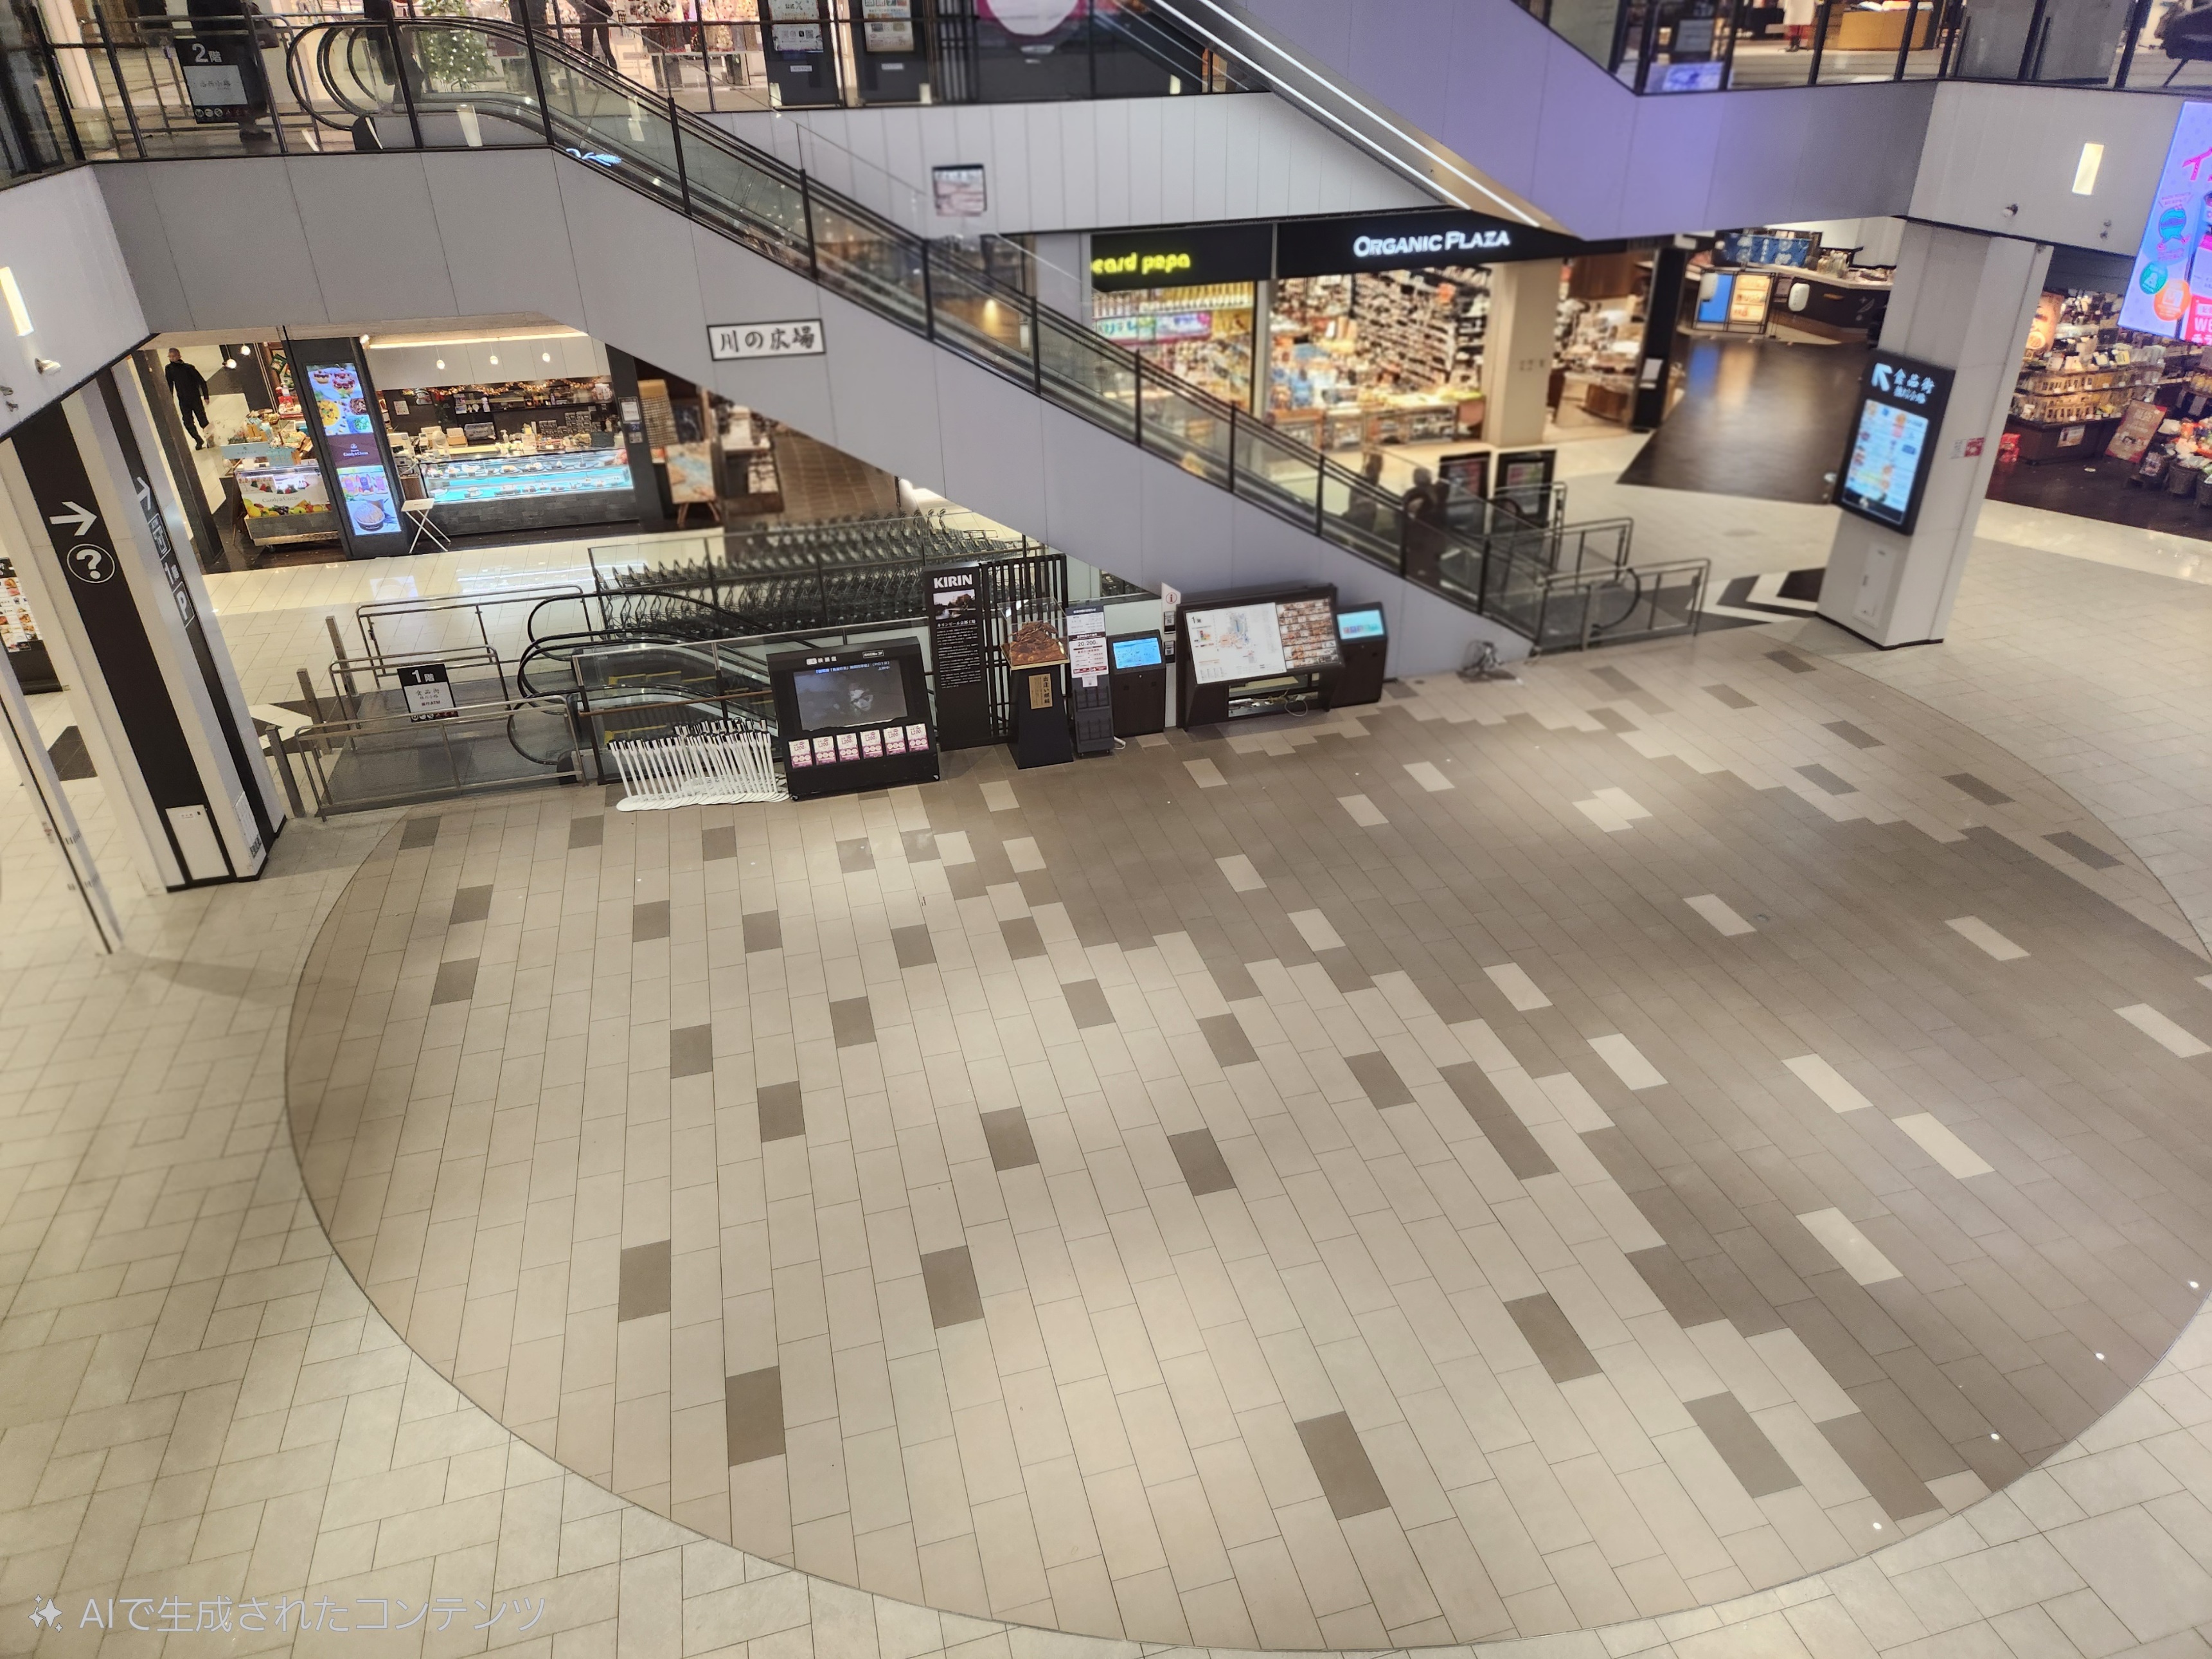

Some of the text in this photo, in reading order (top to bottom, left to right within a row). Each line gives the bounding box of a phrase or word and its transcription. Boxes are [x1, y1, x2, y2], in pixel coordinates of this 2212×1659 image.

[192, 43, 222, 63] 2階
[1353, 229, 1510, 258] ORGANIC PLAZA
[1141, 253, 1190, 276] papa
[720, 325, 815, 353] 川の広場
[1893, 368, 1935, 395] 食品街
[933, 573, 973, 589] KIRIN
[176, 590, 188, 621] P
[411, 669, 435, 683] 1階
